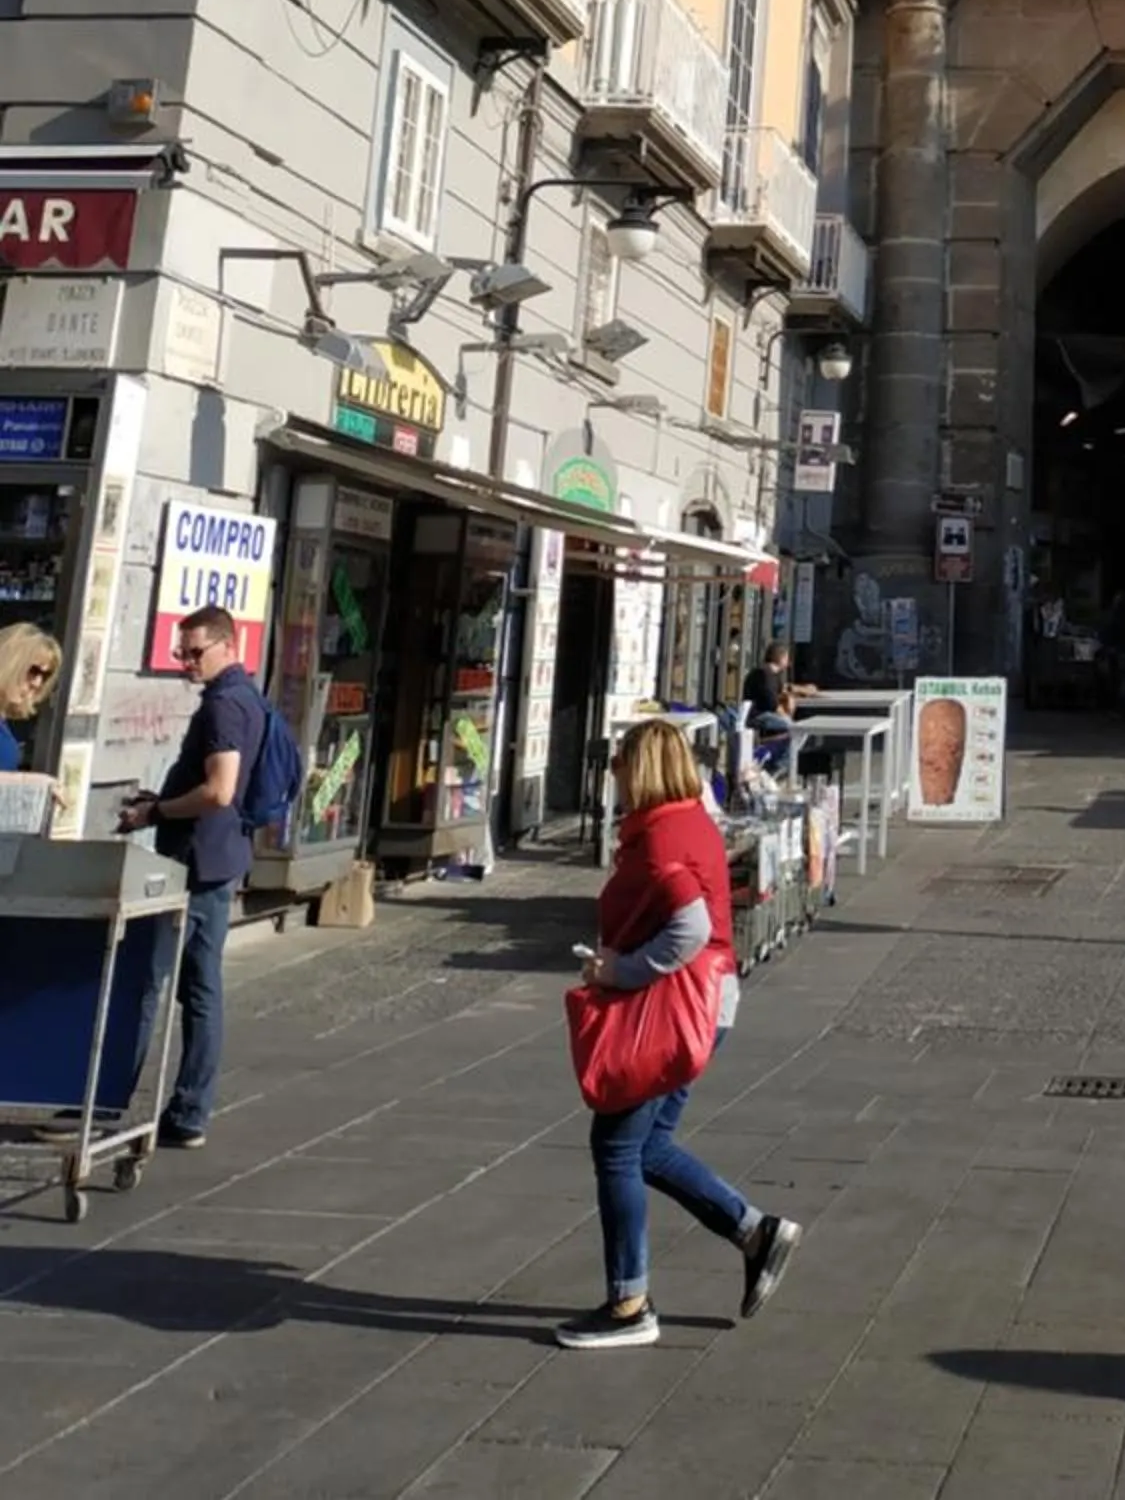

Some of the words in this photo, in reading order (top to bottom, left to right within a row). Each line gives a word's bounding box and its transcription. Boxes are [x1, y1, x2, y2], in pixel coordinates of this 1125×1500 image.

[47, 312, 99, 334] DANTE
[176, 510, 266, 562] COMPRO
[179, 566, 249, 612] LIBRI
